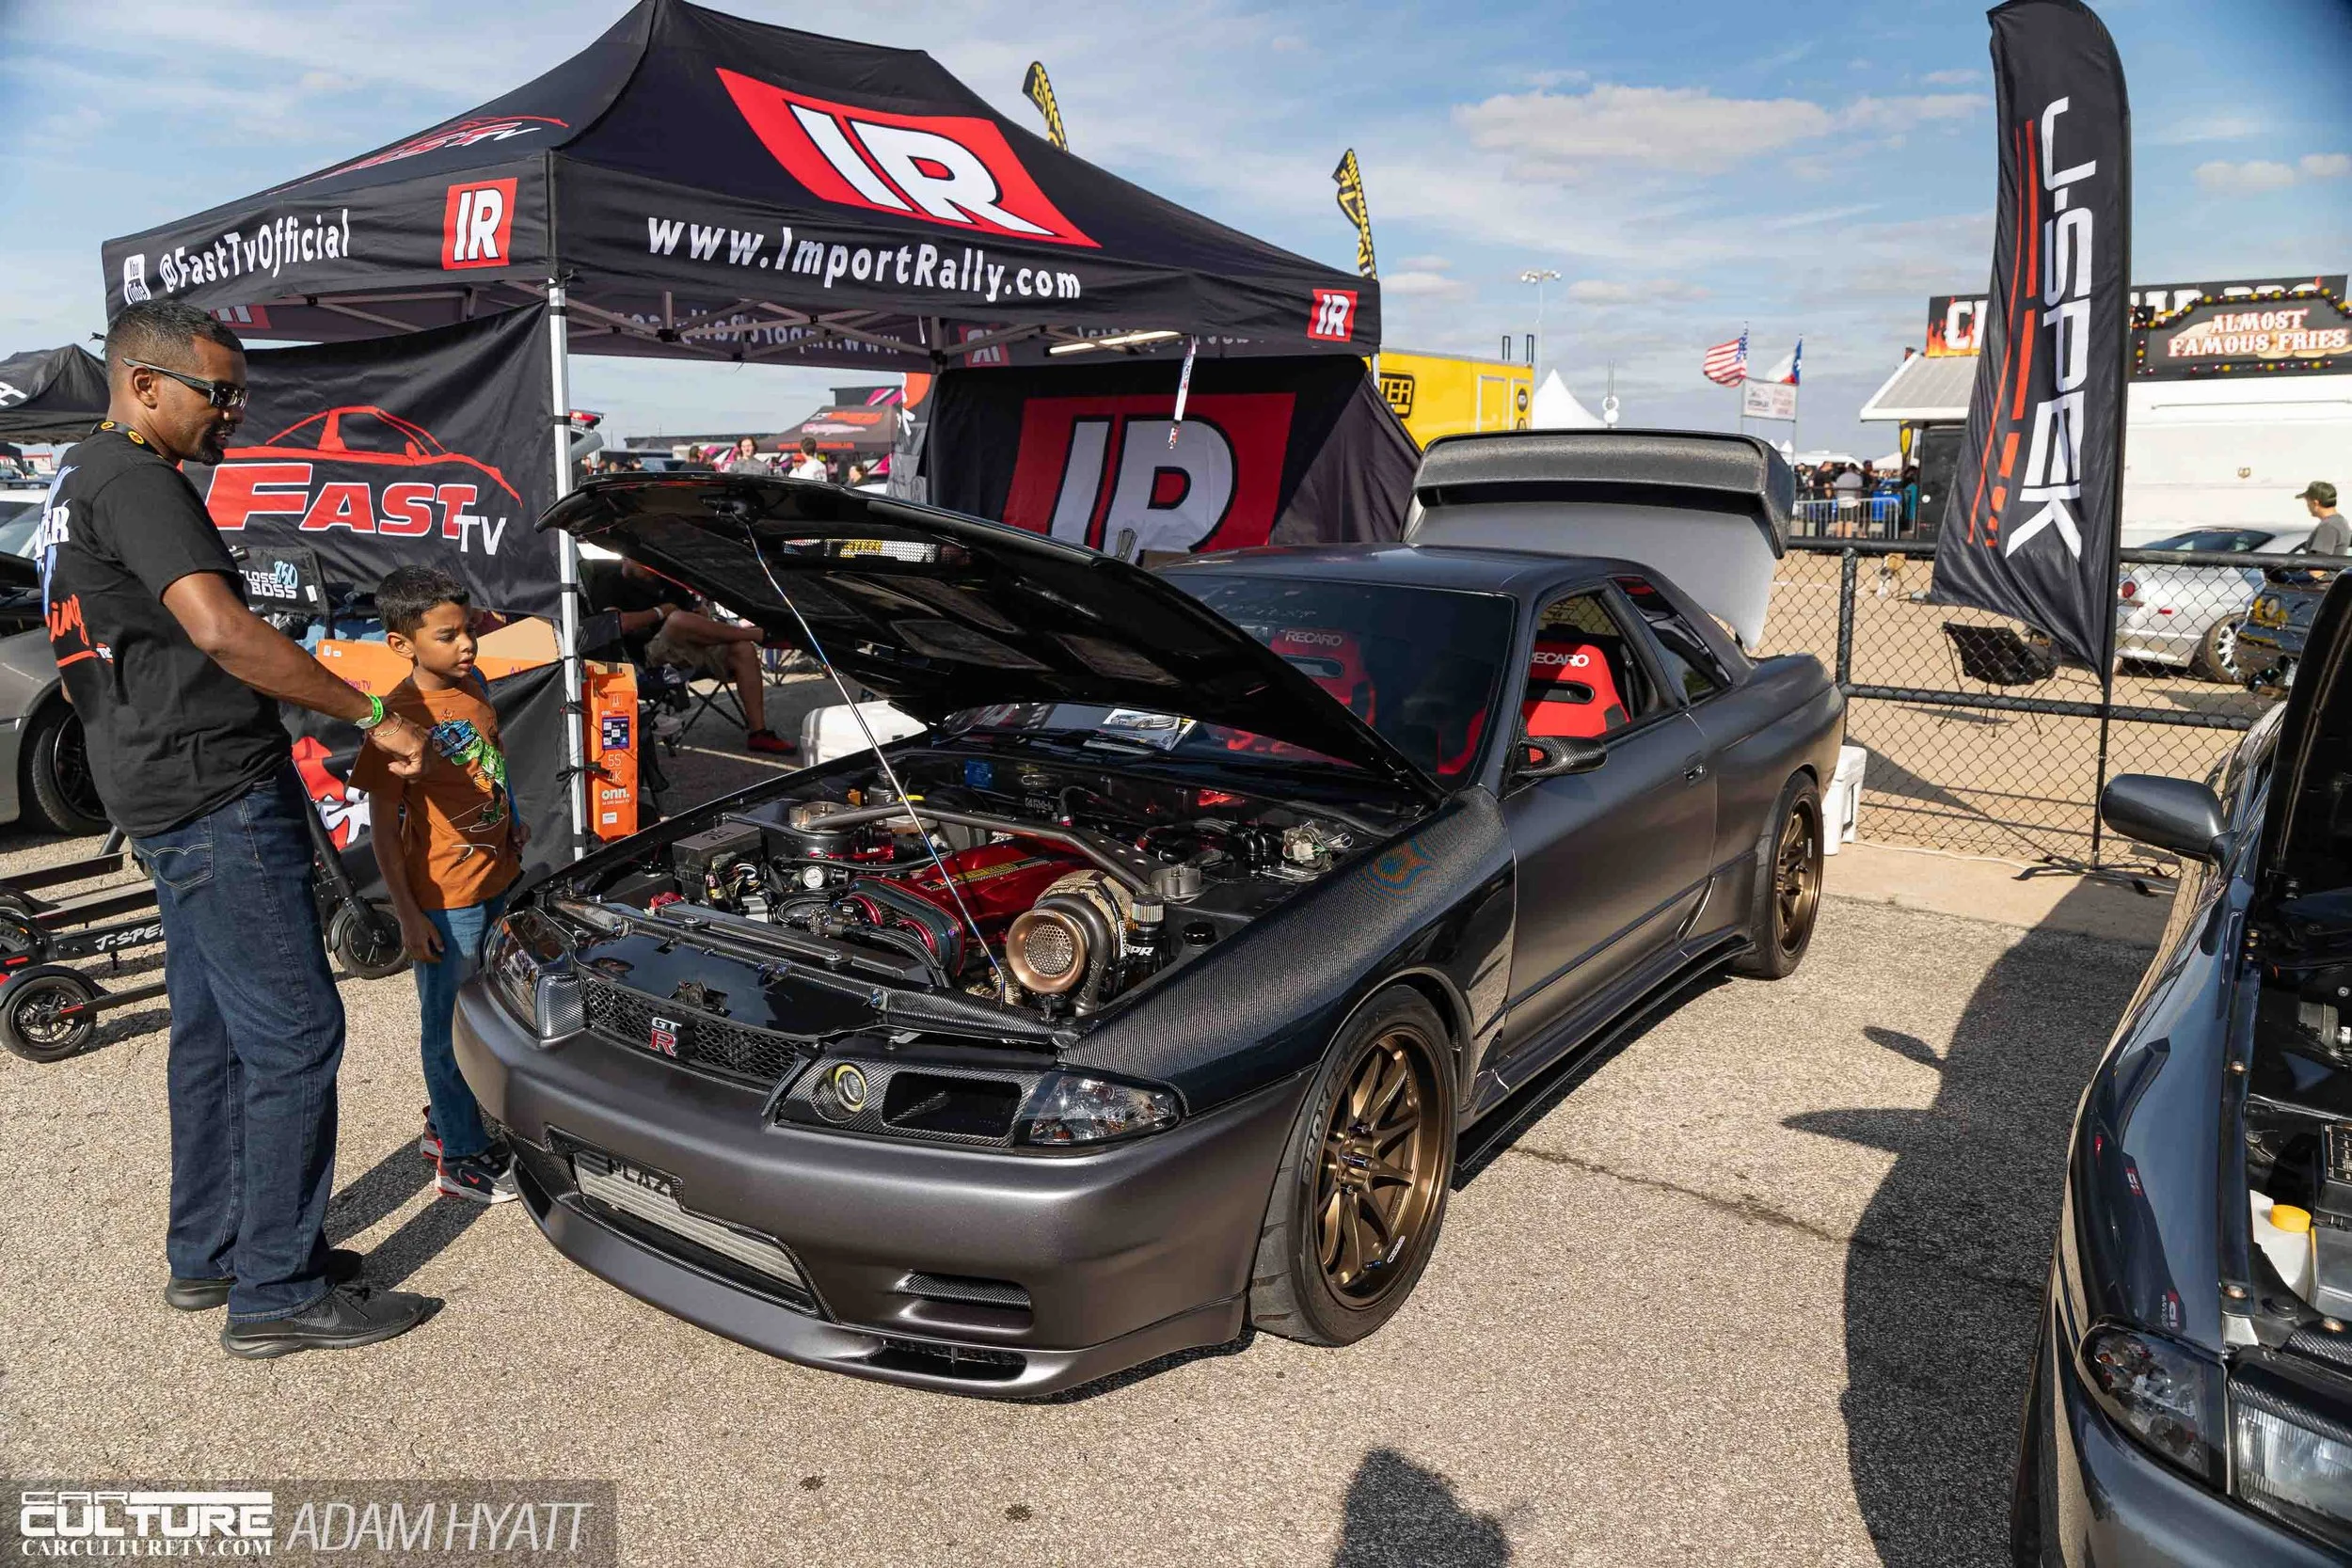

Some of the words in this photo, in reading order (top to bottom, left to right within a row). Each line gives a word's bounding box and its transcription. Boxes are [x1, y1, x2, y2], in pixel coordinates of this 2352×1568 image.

[789, 103, 1057, 237] IR
[453, 187, 504, 262] IR
[159, 208, 350, 293] @FastTvOfficial
[647, 216, 1081, 302] www.ImportRally.com
[1316, 293, 1351, 337] IR
[2006, 97, 2096, 562] J-SPEK
[2210, 308, 2311, 333] ALMOST
[2168, 325, 2270, 357] FAMOUS
[2275, 326, 2351, 353] FRIES
[1379, 378, 1411, 404] TER
[204, 463, 479, 540] FAST
[1049, 418, 1234, 553] IR
[453, 514, 507, 556] TV
[250, 581, 297, 599] BOSS
[1285, 630, 1343, 647] RECARO
[601, 785, 630, 800] onn.
[649, 1029, 676, 1057] R
[652, 1016, 682, 1034] GT
[607, 1158, 675, 1199] PLAZ
